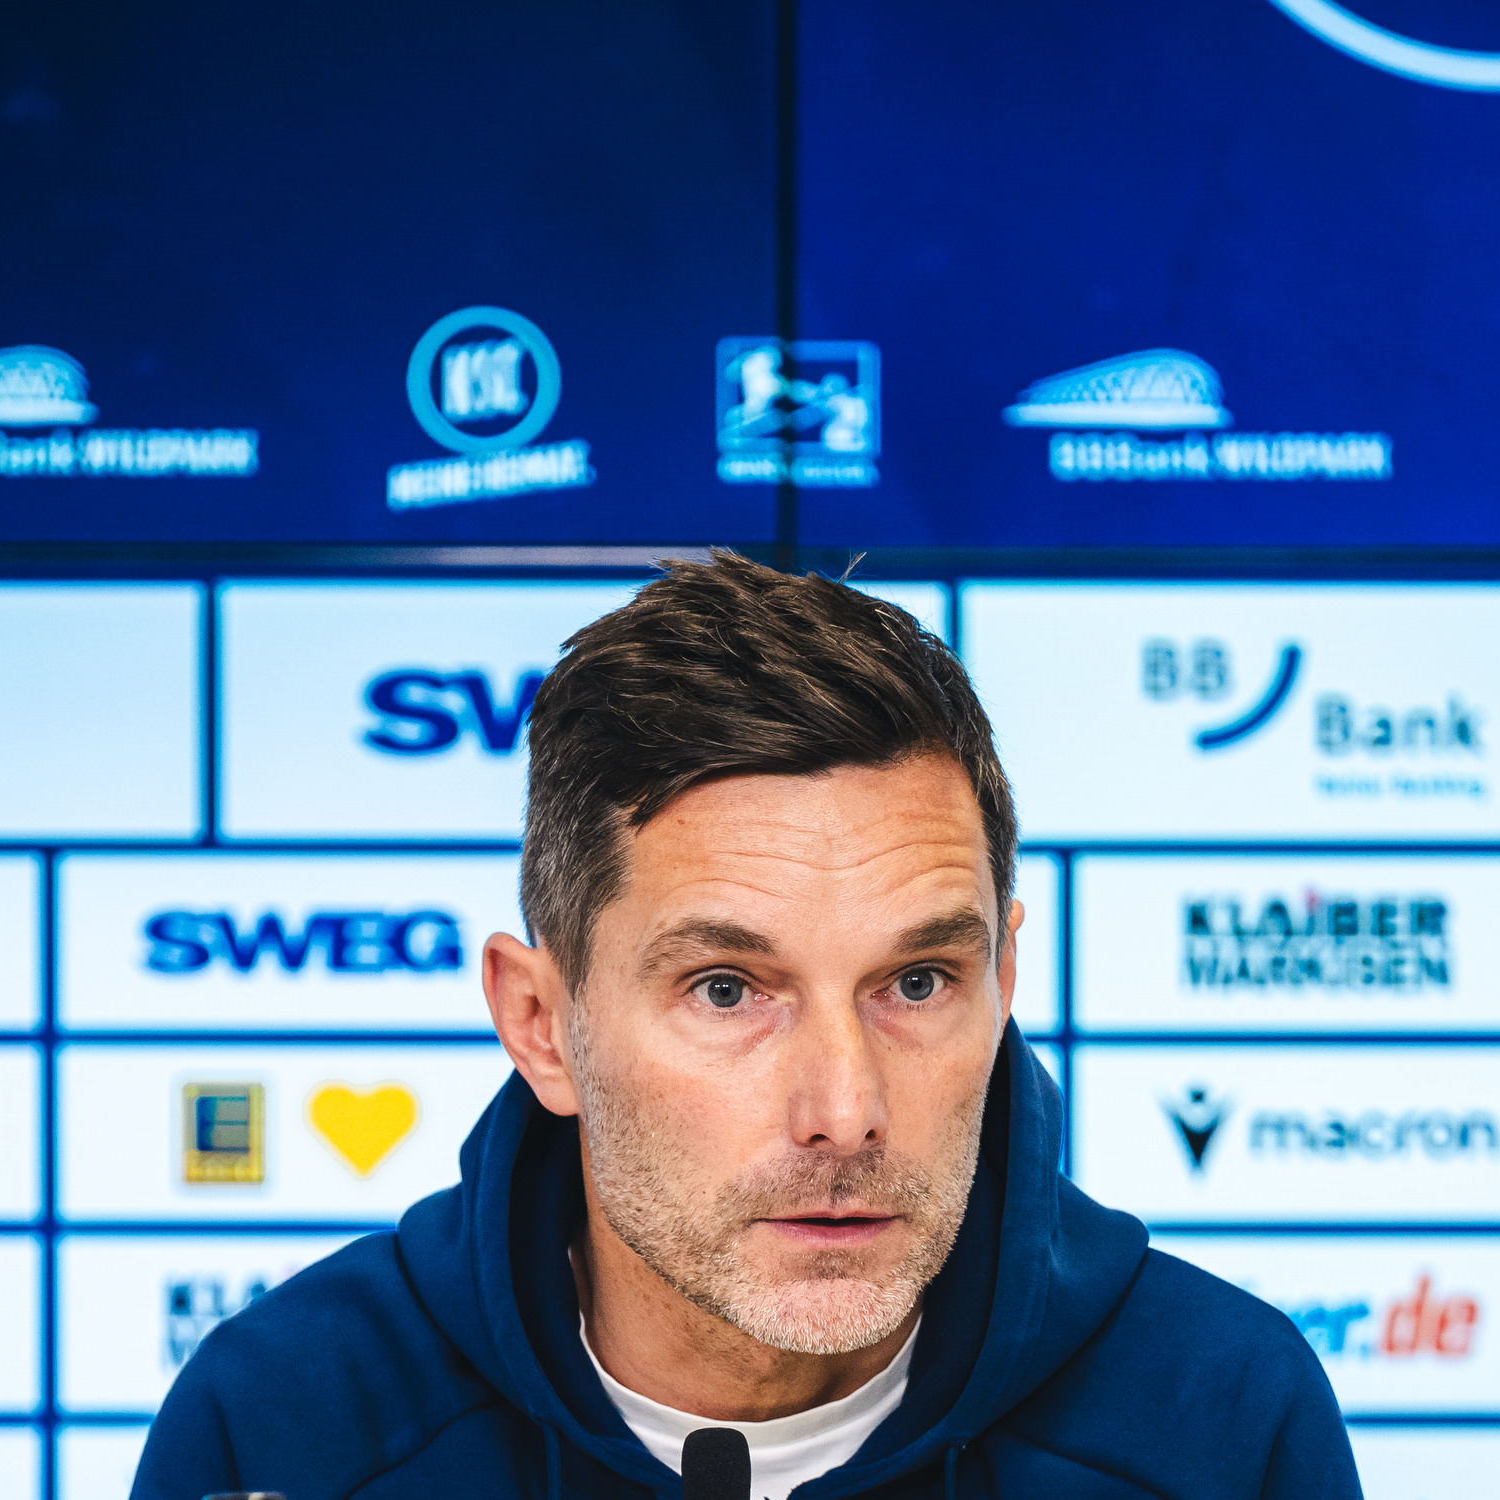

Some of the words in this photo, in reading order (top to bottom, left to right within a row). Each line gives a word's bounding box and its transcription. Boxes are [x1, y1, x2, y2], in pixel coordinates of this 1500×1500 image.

[1315, 697, 1485, 755] Bank
[141, 906, 464, 974] SWEG
[1250, 1110, 1500, 1161] macron
